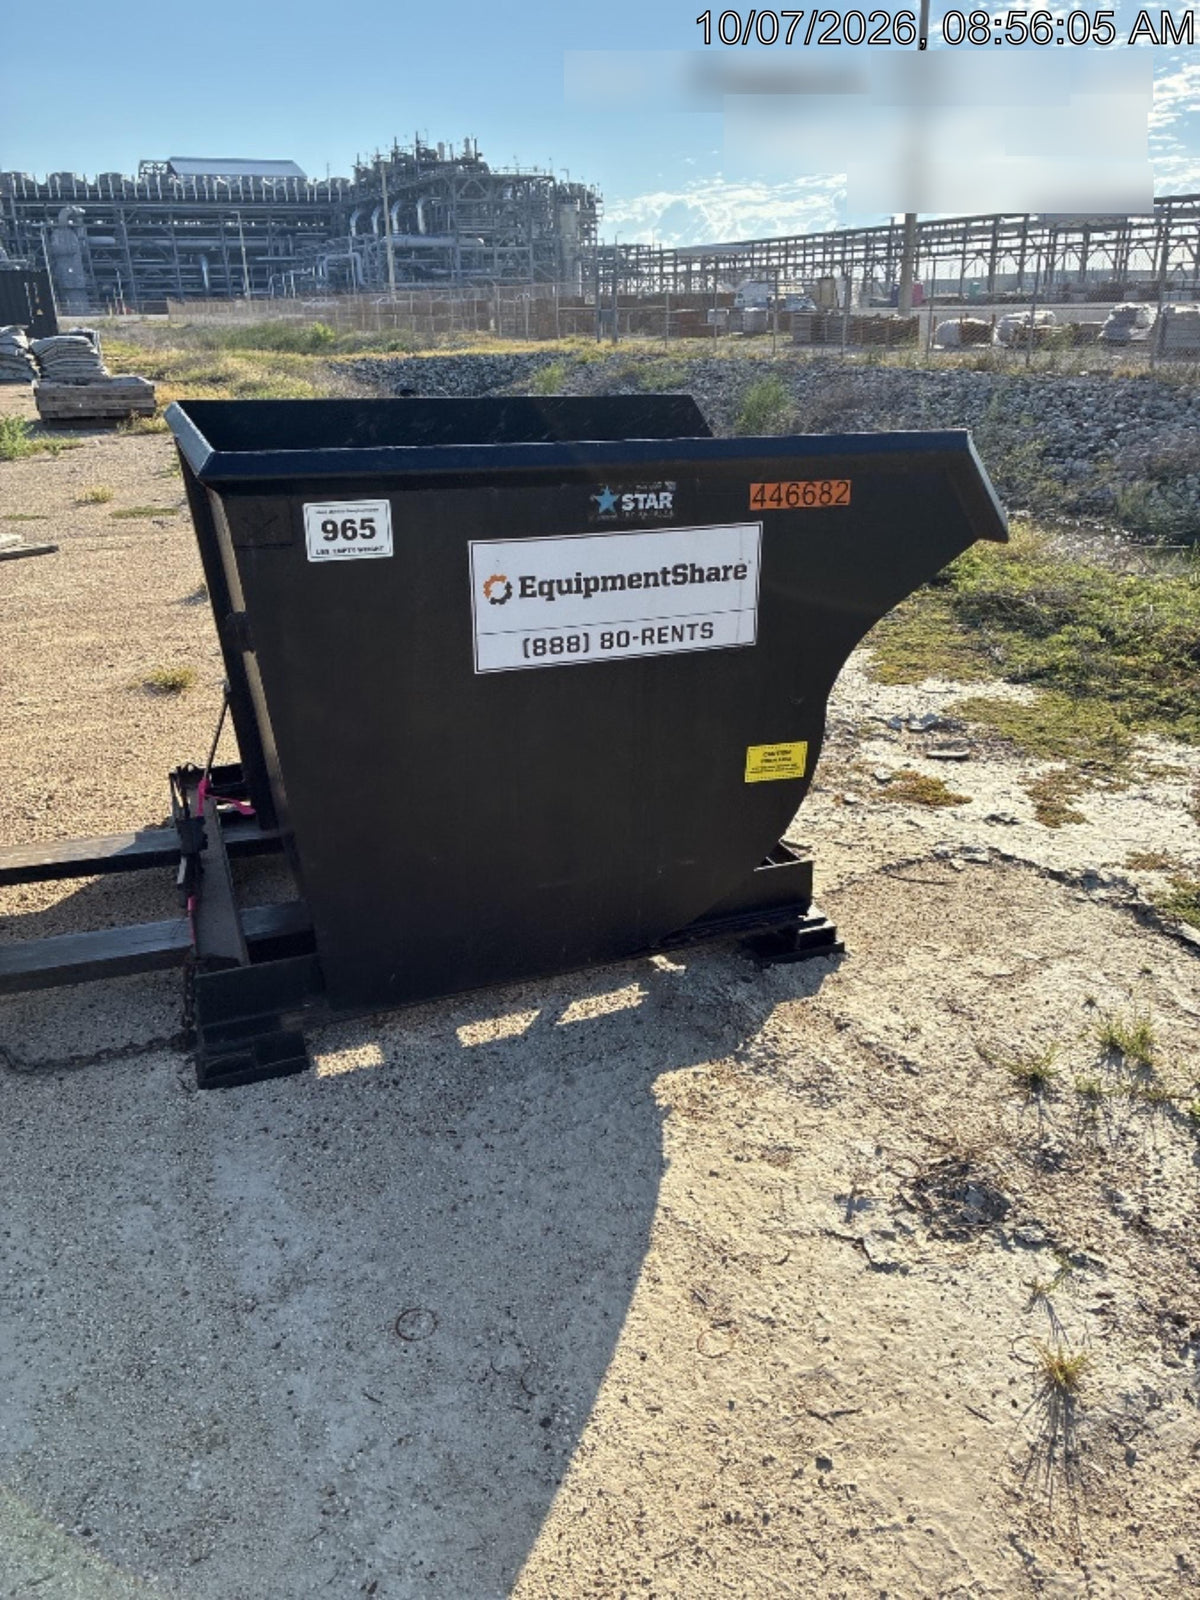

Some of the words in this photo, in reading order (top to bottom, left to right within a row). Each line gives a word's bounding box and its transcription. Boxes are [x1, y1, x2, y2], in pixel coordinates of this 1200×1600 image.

[621, 491, 673, 511] STAR
[751, 480, 850, 508] 446682
[321, 517, 376, 541] 965
[518, 562, 748, 602] EquipmentShare
[600, 621, 714, 650] 80-RENTS
